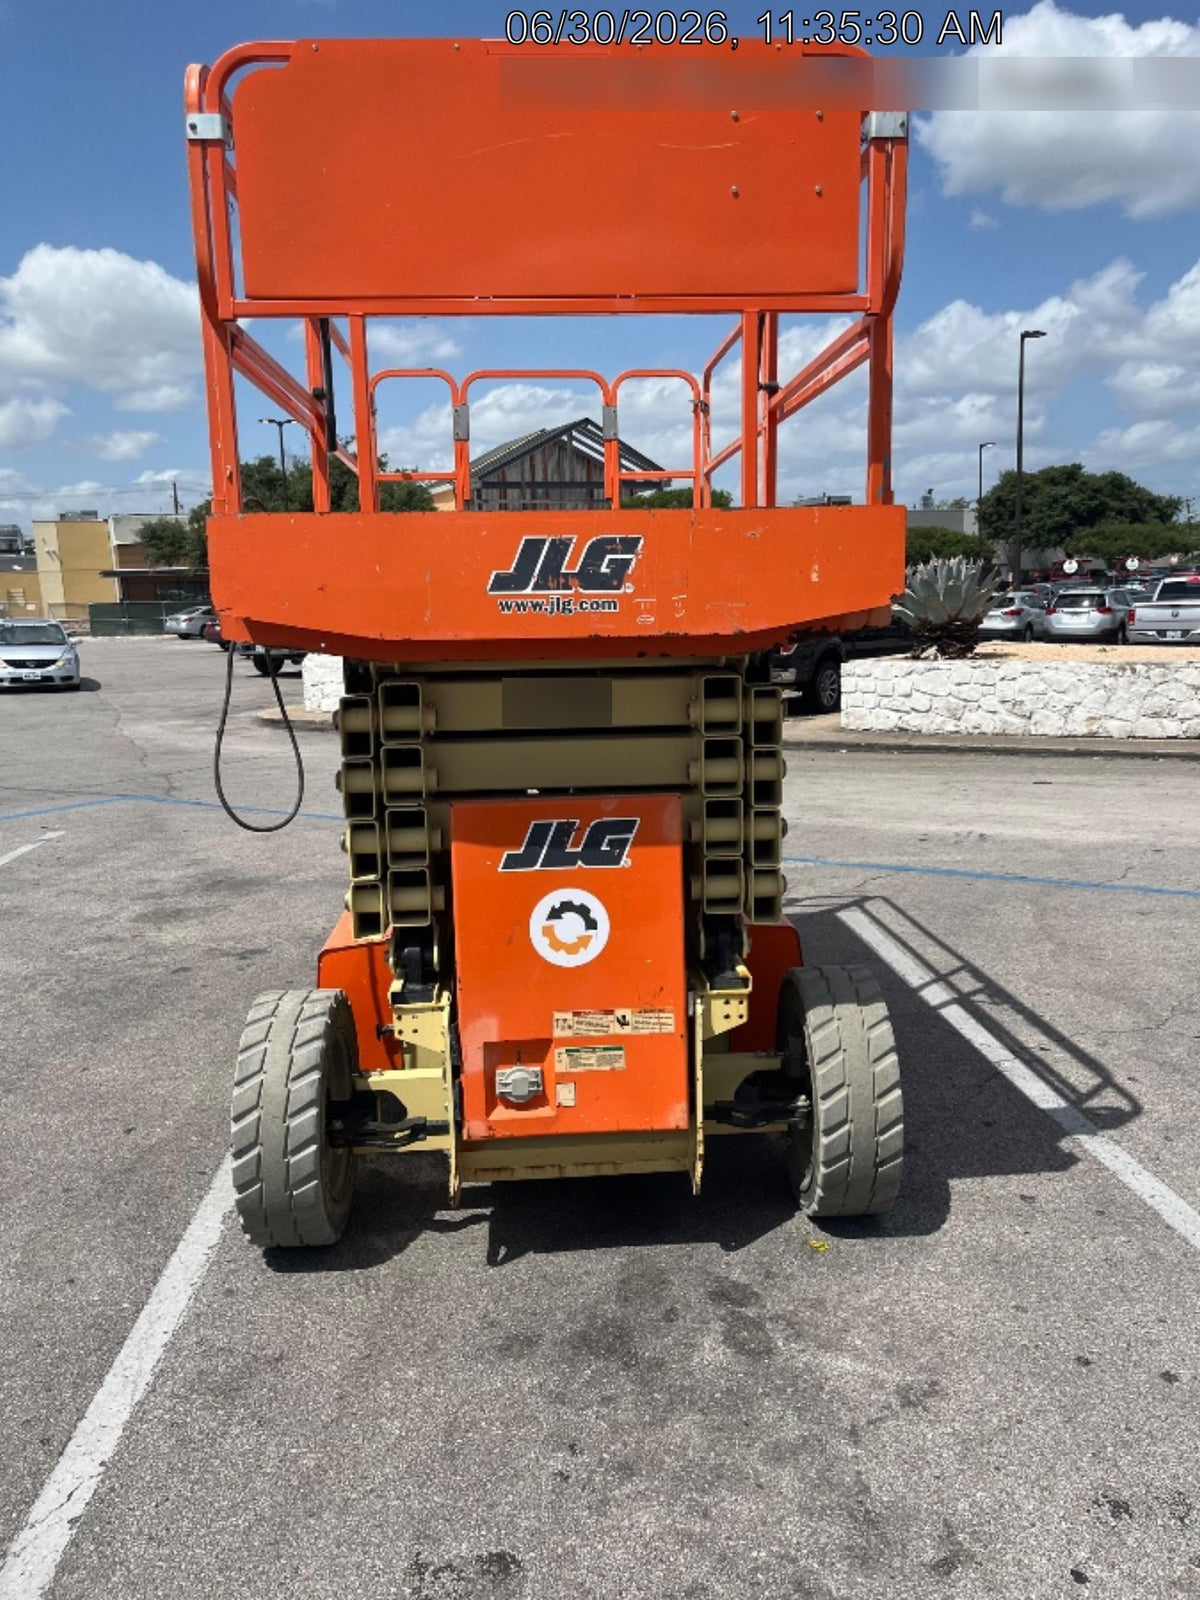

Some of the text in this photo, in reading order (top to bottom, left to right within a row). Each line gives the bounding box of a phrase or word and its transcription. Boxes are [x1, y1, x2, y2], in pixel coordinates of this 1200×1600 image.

[487, 535, 644, 595] JLG
[498, 597, 620, 615] www.jlg.com
[498, 817, 641, 872] JLG
